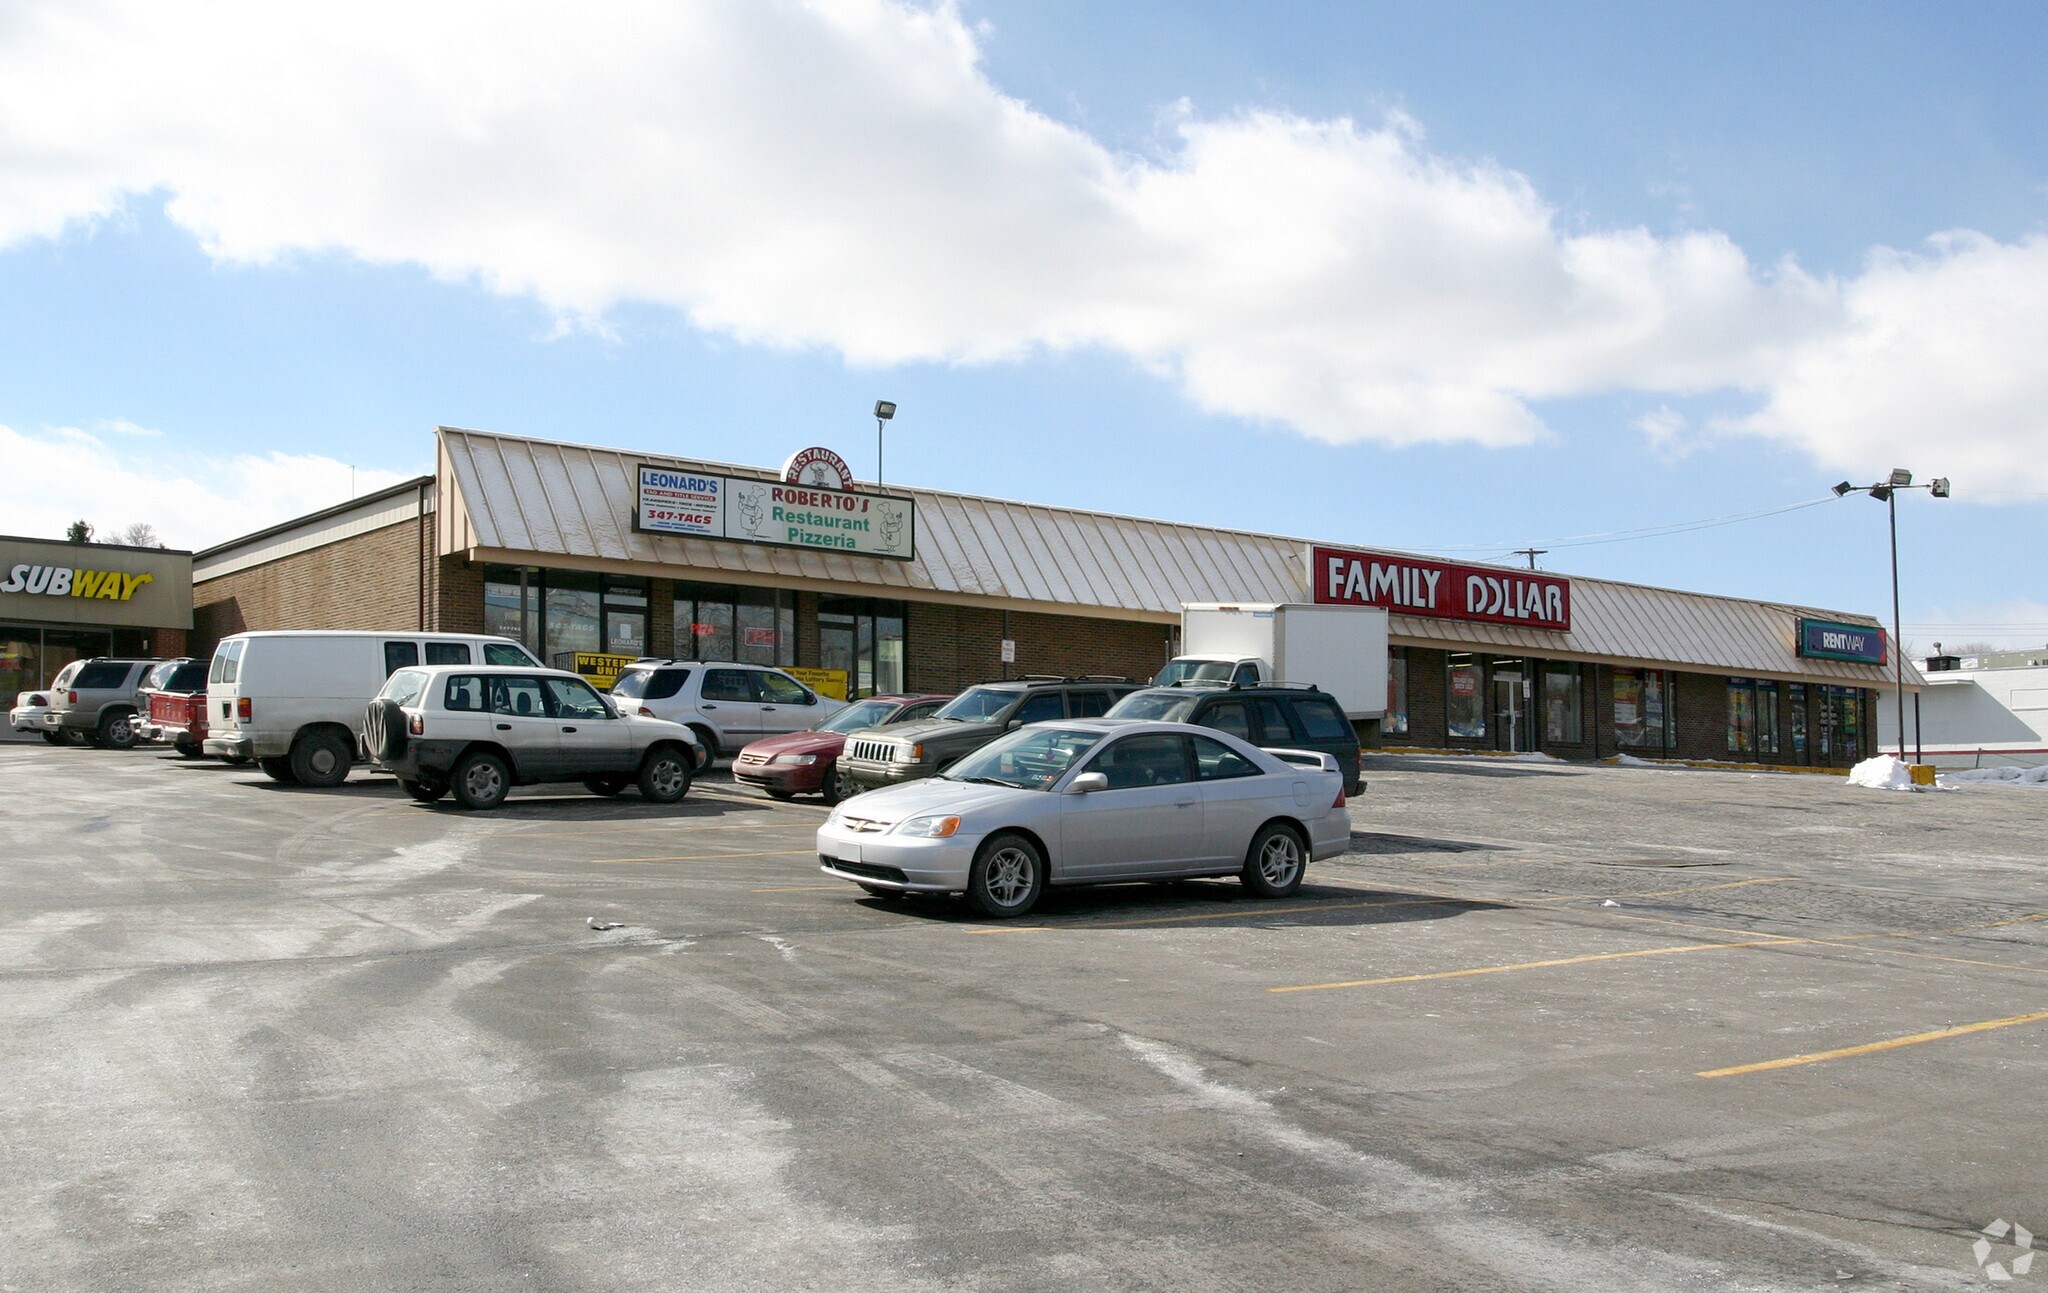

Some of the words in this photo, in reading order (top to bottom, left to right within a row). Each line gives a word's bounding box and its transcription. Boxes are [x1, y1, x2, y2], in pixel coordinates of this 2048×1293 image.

[788, 449, 853, 488] RESTAURANT
[642, 472, 718, 493] LEONARD'S
[771, 487, 870, 513] ROBERTO'S
[647, 510, 712, 525] 347-TAGS
[772, 506, 870, 532] Restaurant
[788, 528, 856, 549] Pizzeria
[0, 564, 154, 601] SUBWAY
[1328, 556, 1442, 609] FAMILY
[1466, 575, 1564, 623] DOLLAR
[1823, 632, 1865, 652] RENTWAY
[597, 666, 623, 676] UNI
